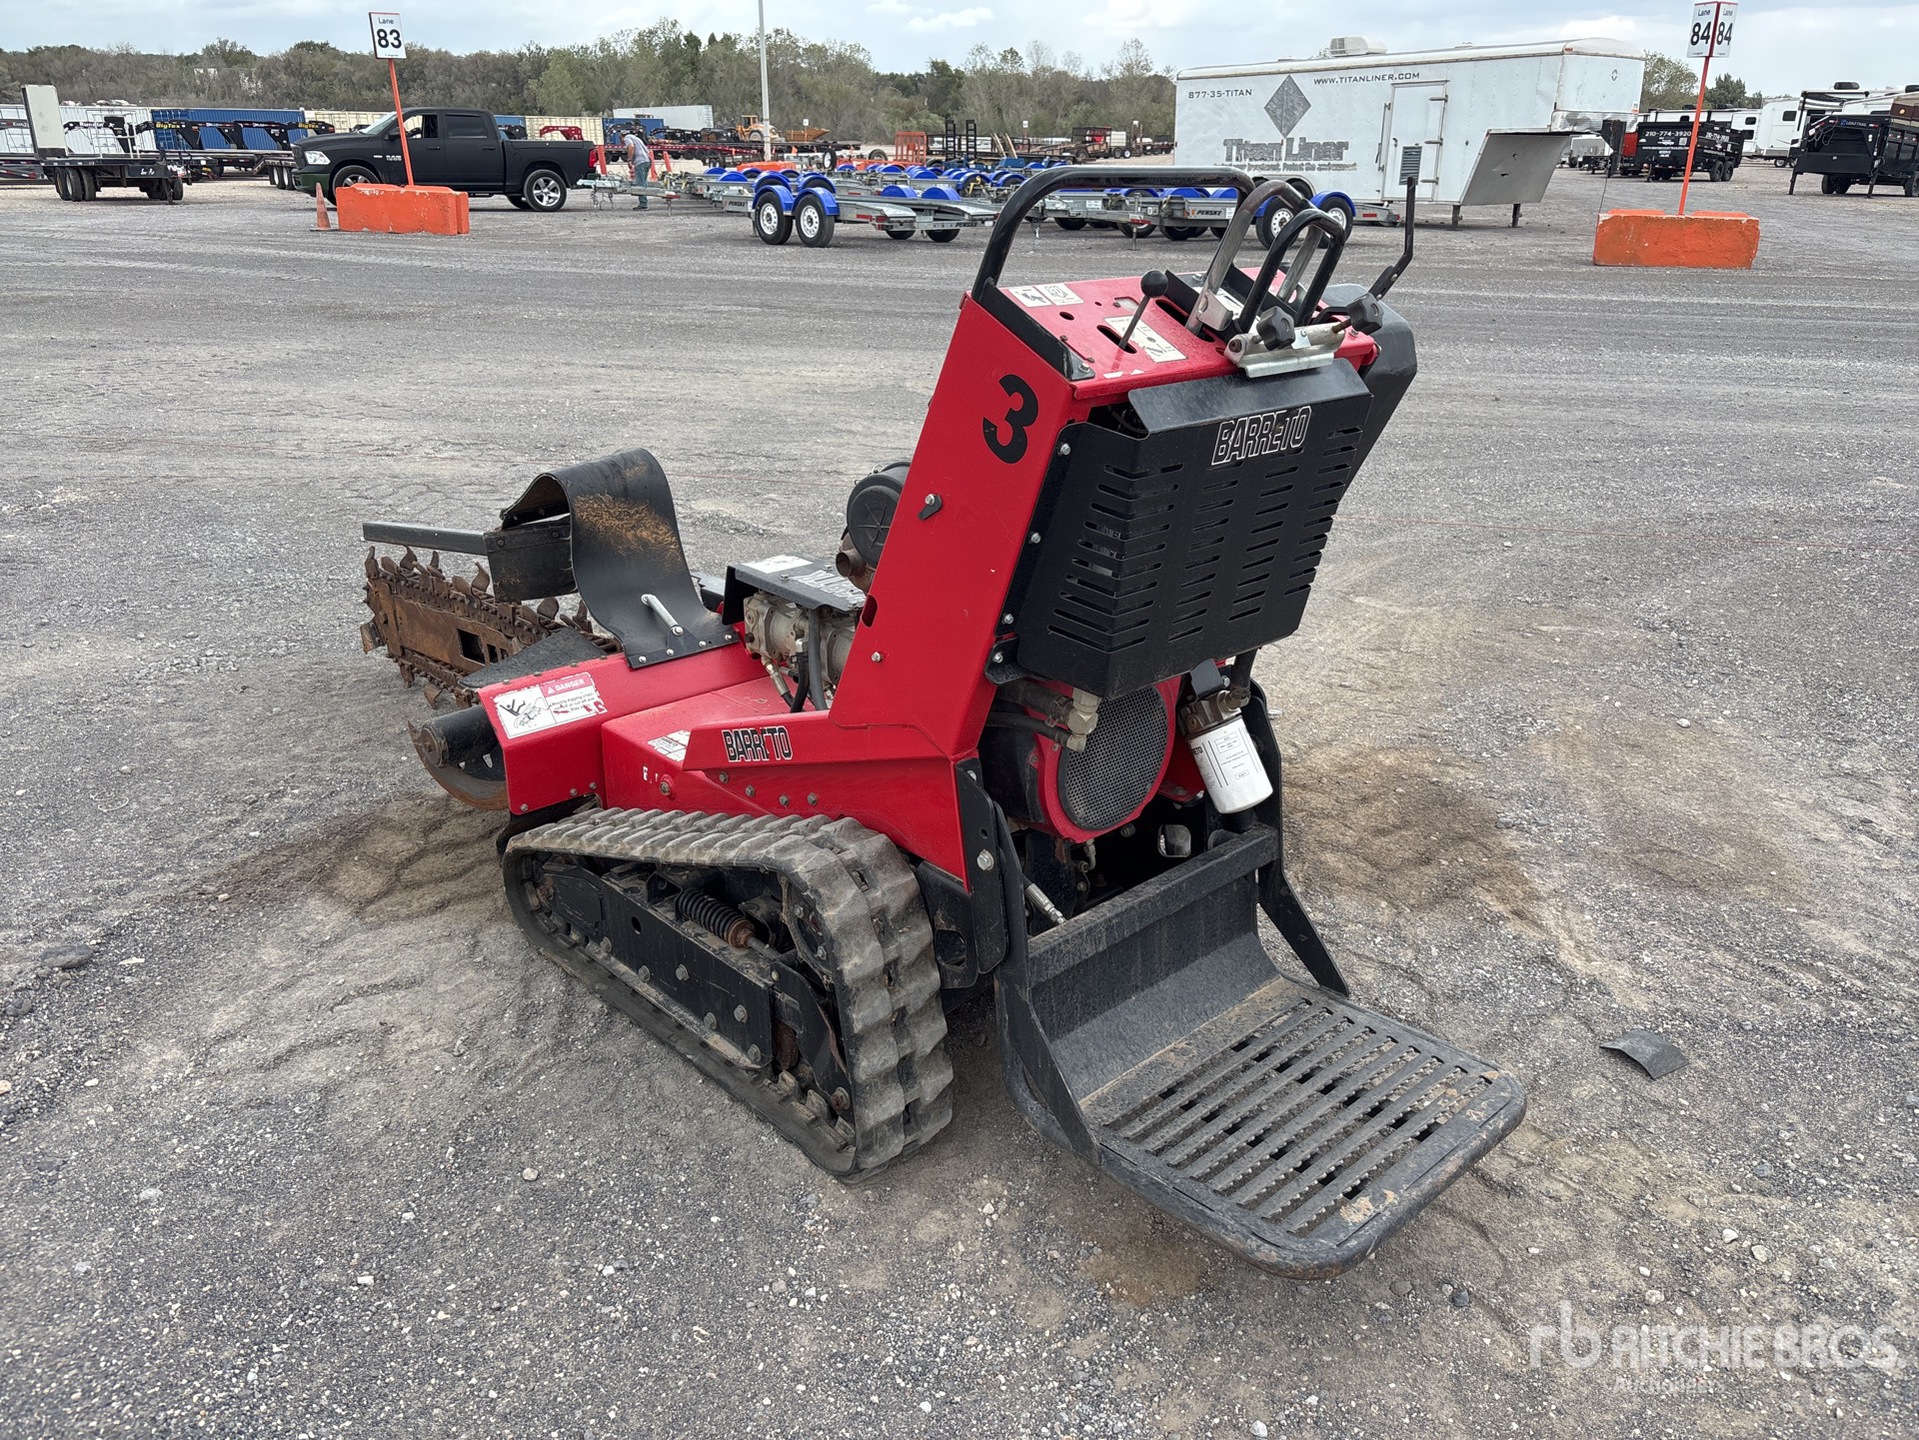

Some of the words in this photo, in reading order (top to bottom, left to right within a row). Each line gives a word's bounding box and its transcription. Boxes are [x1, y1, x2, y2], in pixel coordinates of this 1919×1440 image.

[1723, 8, 1733, 16] Lane
[376, 28, 402, 49] 83
[1690, 21, 1711, 46] 84
[1716, 21, 1733, 46] 84
[1313, 72, 1420, 85] WWW.TITANLINER.COM
[1188, 88, 1252, 99] 877-35-TITAN
[1223, 138, 1283, 162] Titan
[1284, 137, 1349, 162] Liner
[982, 373, 1039, 464] 3
[554, 679, 586, 691] DANGER
[721, 725, 794, 763] BARRTO
